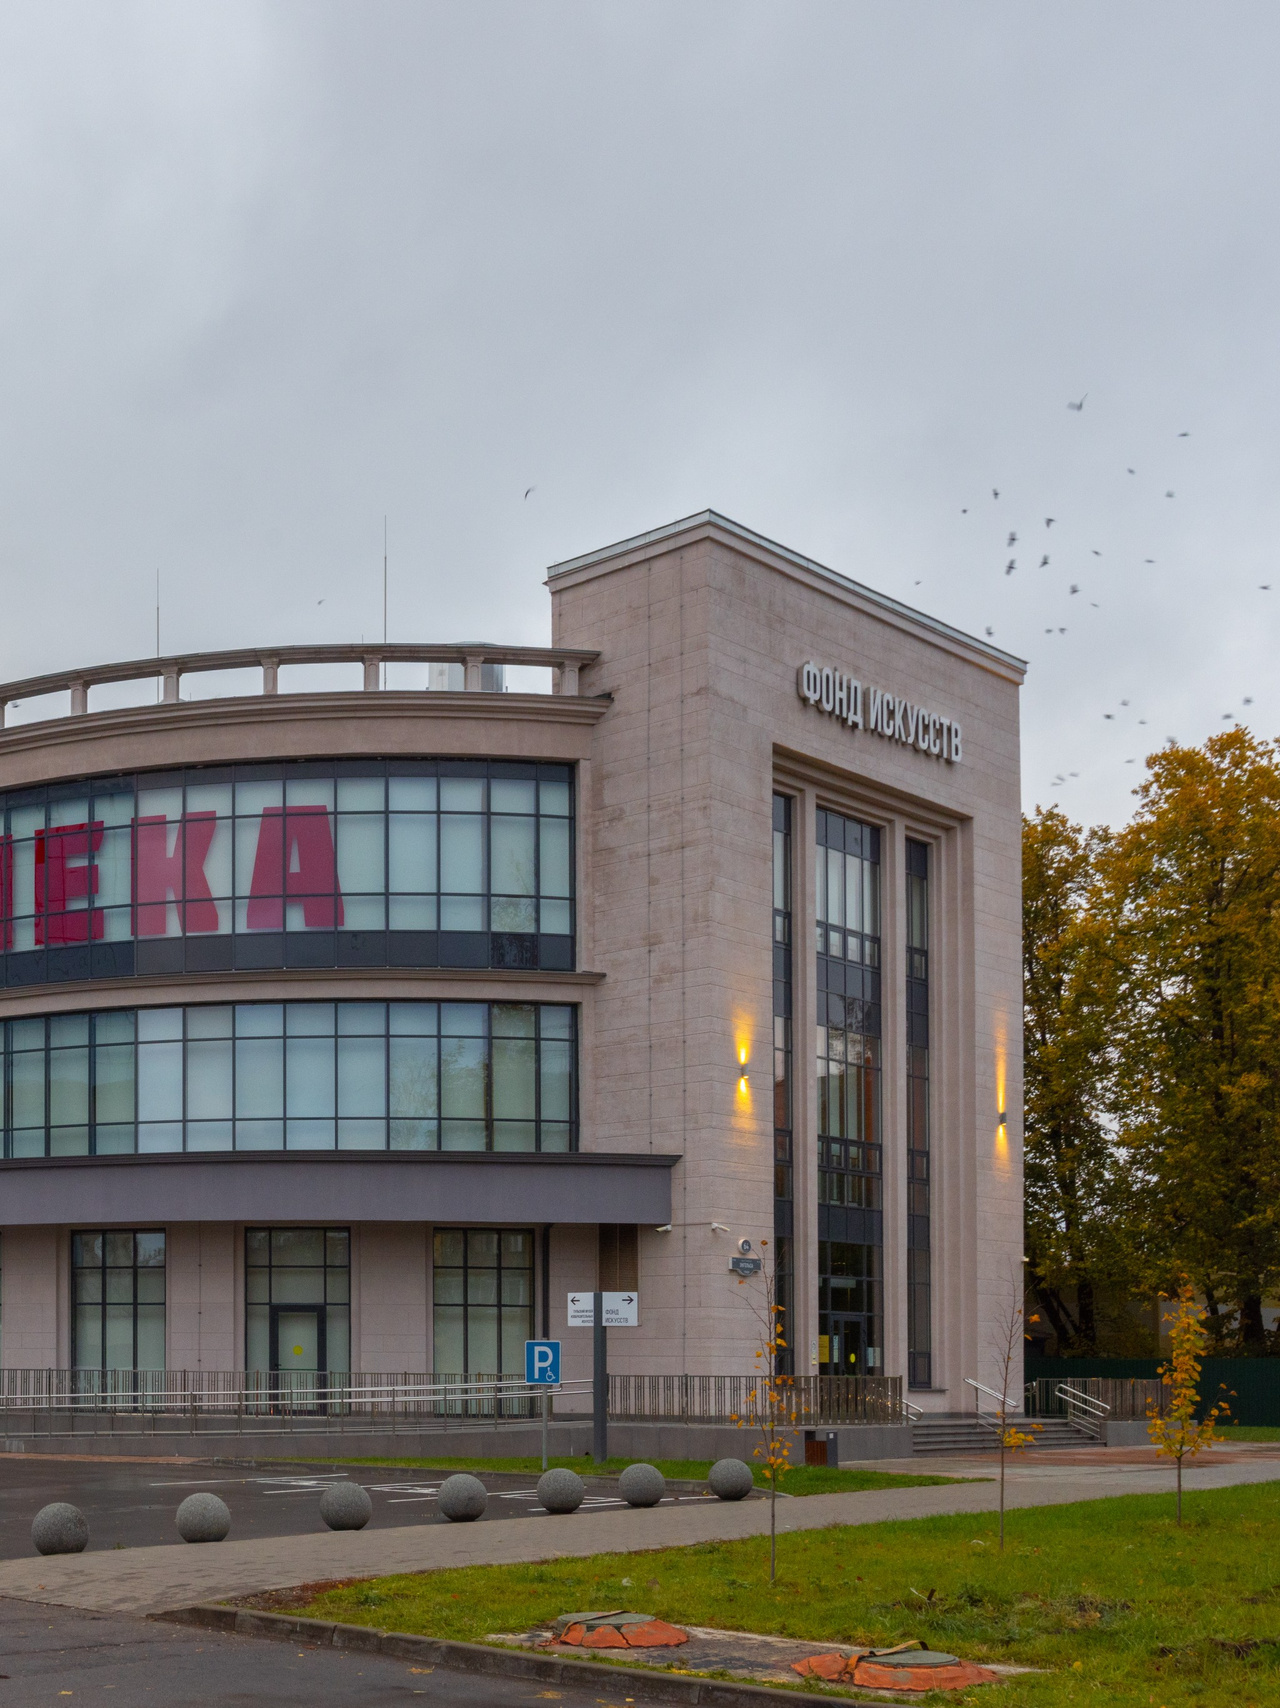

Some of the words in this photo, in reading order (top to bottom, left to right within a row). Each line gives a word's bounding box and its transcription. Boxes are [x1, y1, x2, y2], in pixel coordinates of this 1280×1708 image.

[799, 660, 863, 730] ФОНД
[866, 686, 962, 763] ИСКУССТВ
[534, 1345, 553, 1379] P
